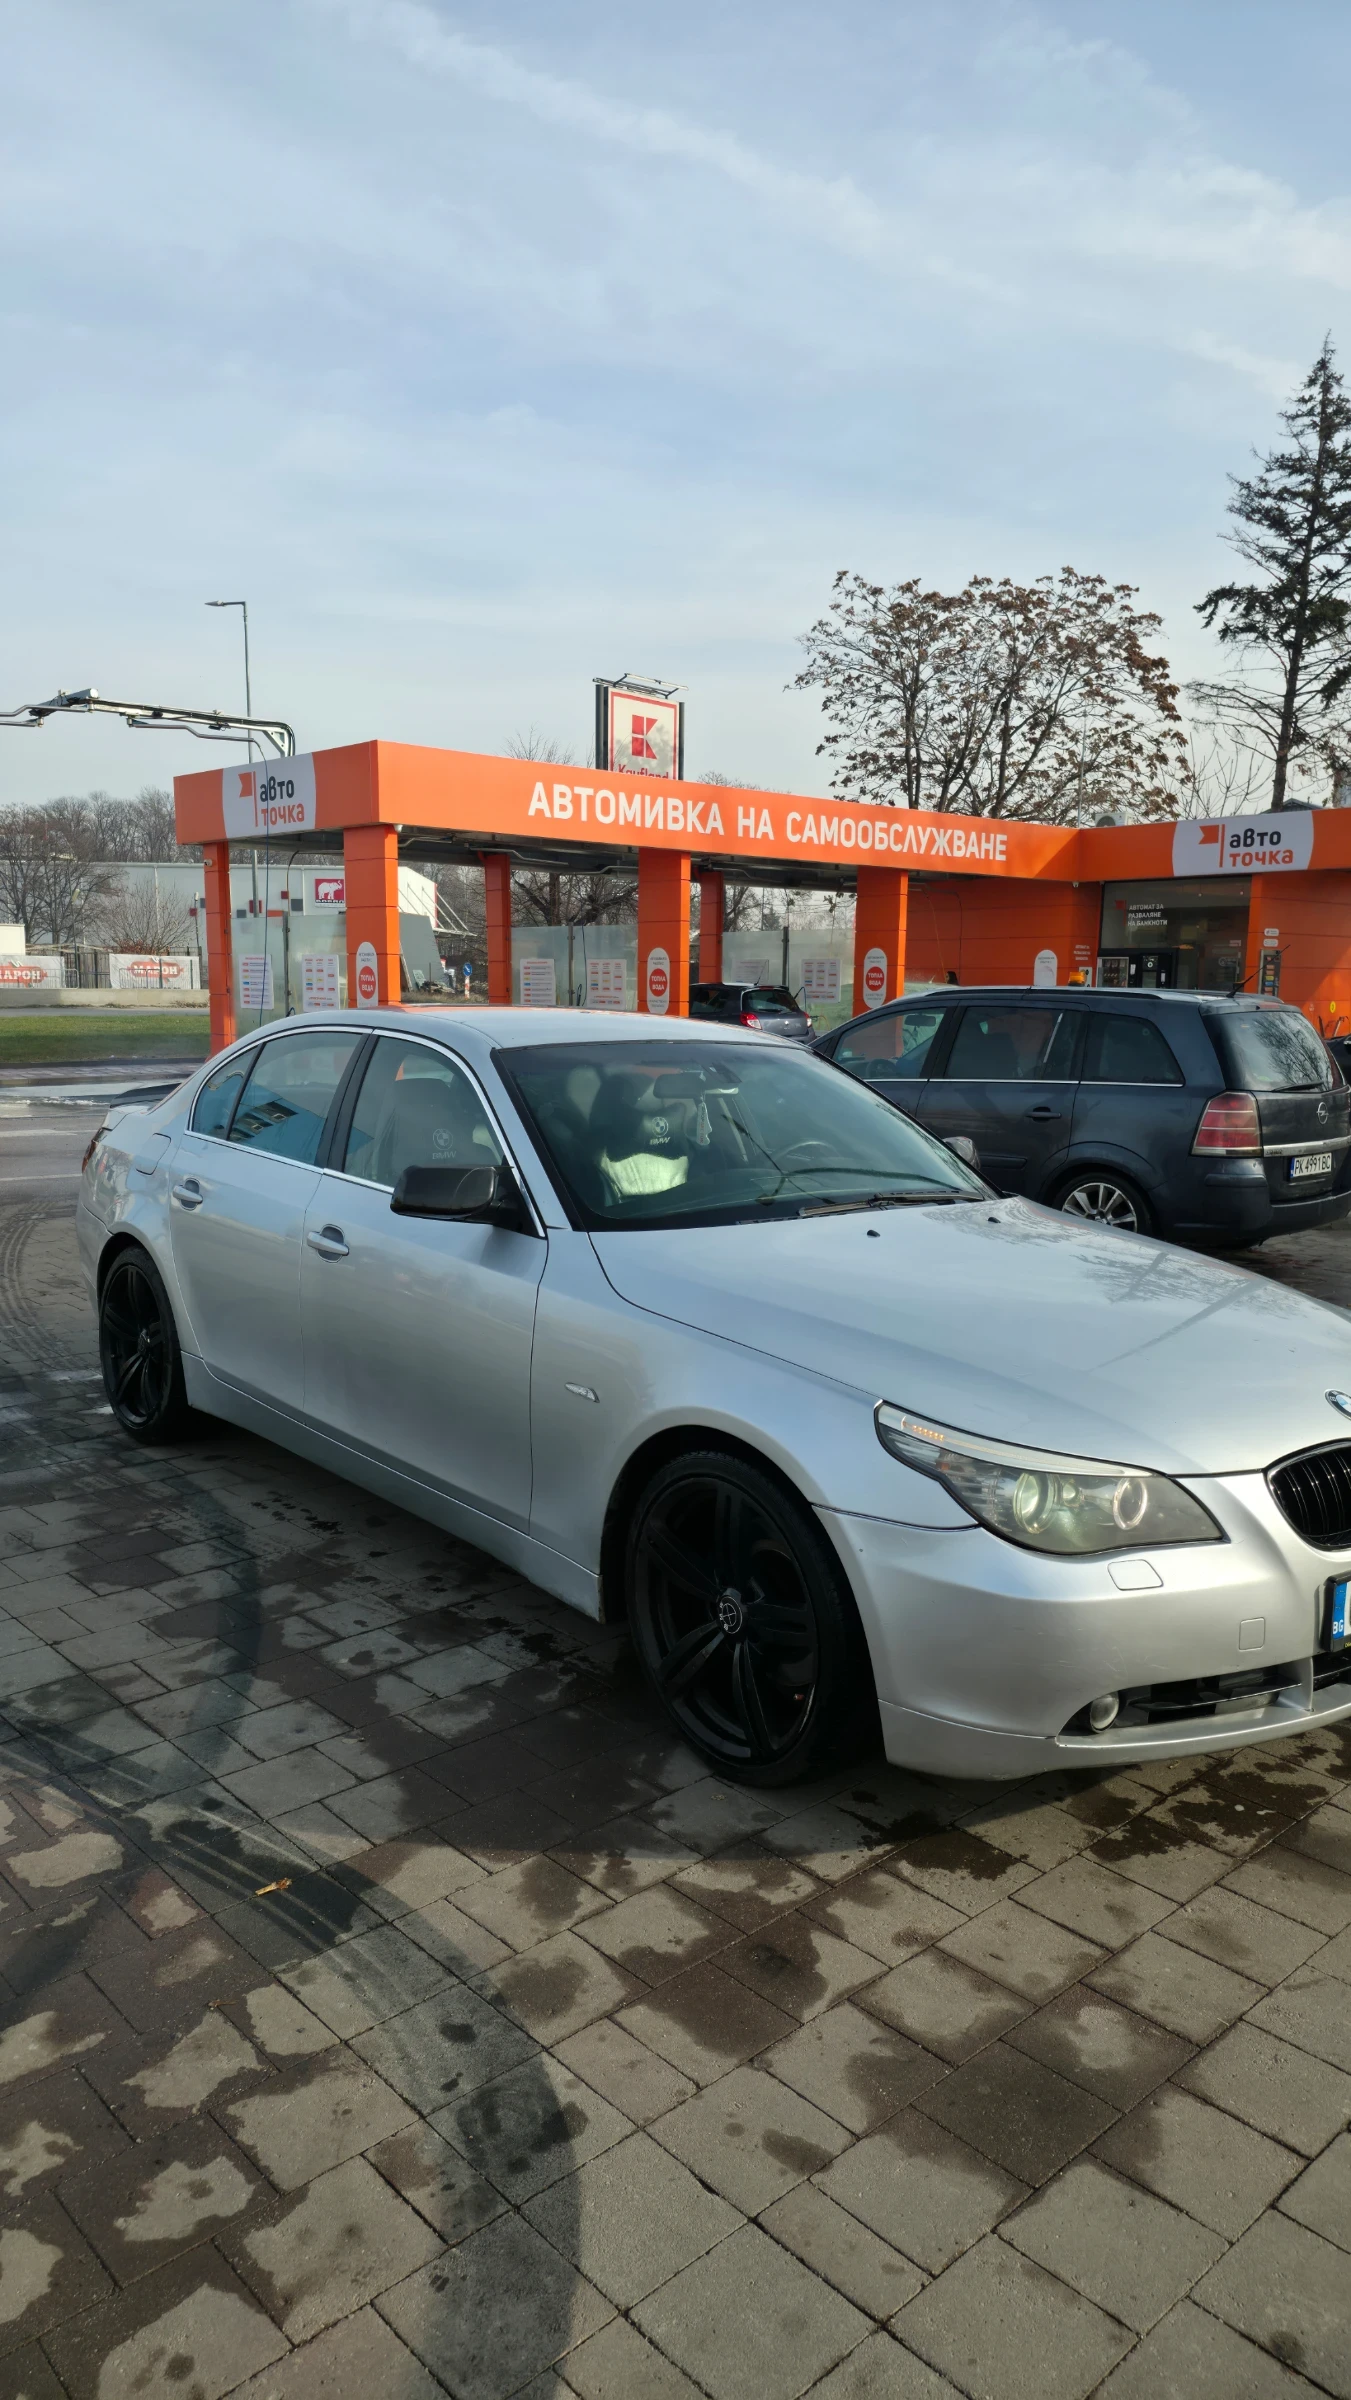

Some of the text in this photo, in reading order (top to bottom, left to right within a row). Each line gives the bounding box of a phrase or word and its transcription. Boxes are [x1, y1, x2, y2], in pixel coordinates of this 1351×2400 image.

[260, 776, 295, 802] авто
[261, 803, 305, 826] точка
[527, 781, 1008, 862] АВТОМИВКА НА САМООБСЛУЖВАНЕ
[1229, 828, 1281, 849] авто
[1229, 849, 1293, 867] точка
[432, 1150, 457, 1160] BMW
[1332, 1619, 1344, 1635] BG
